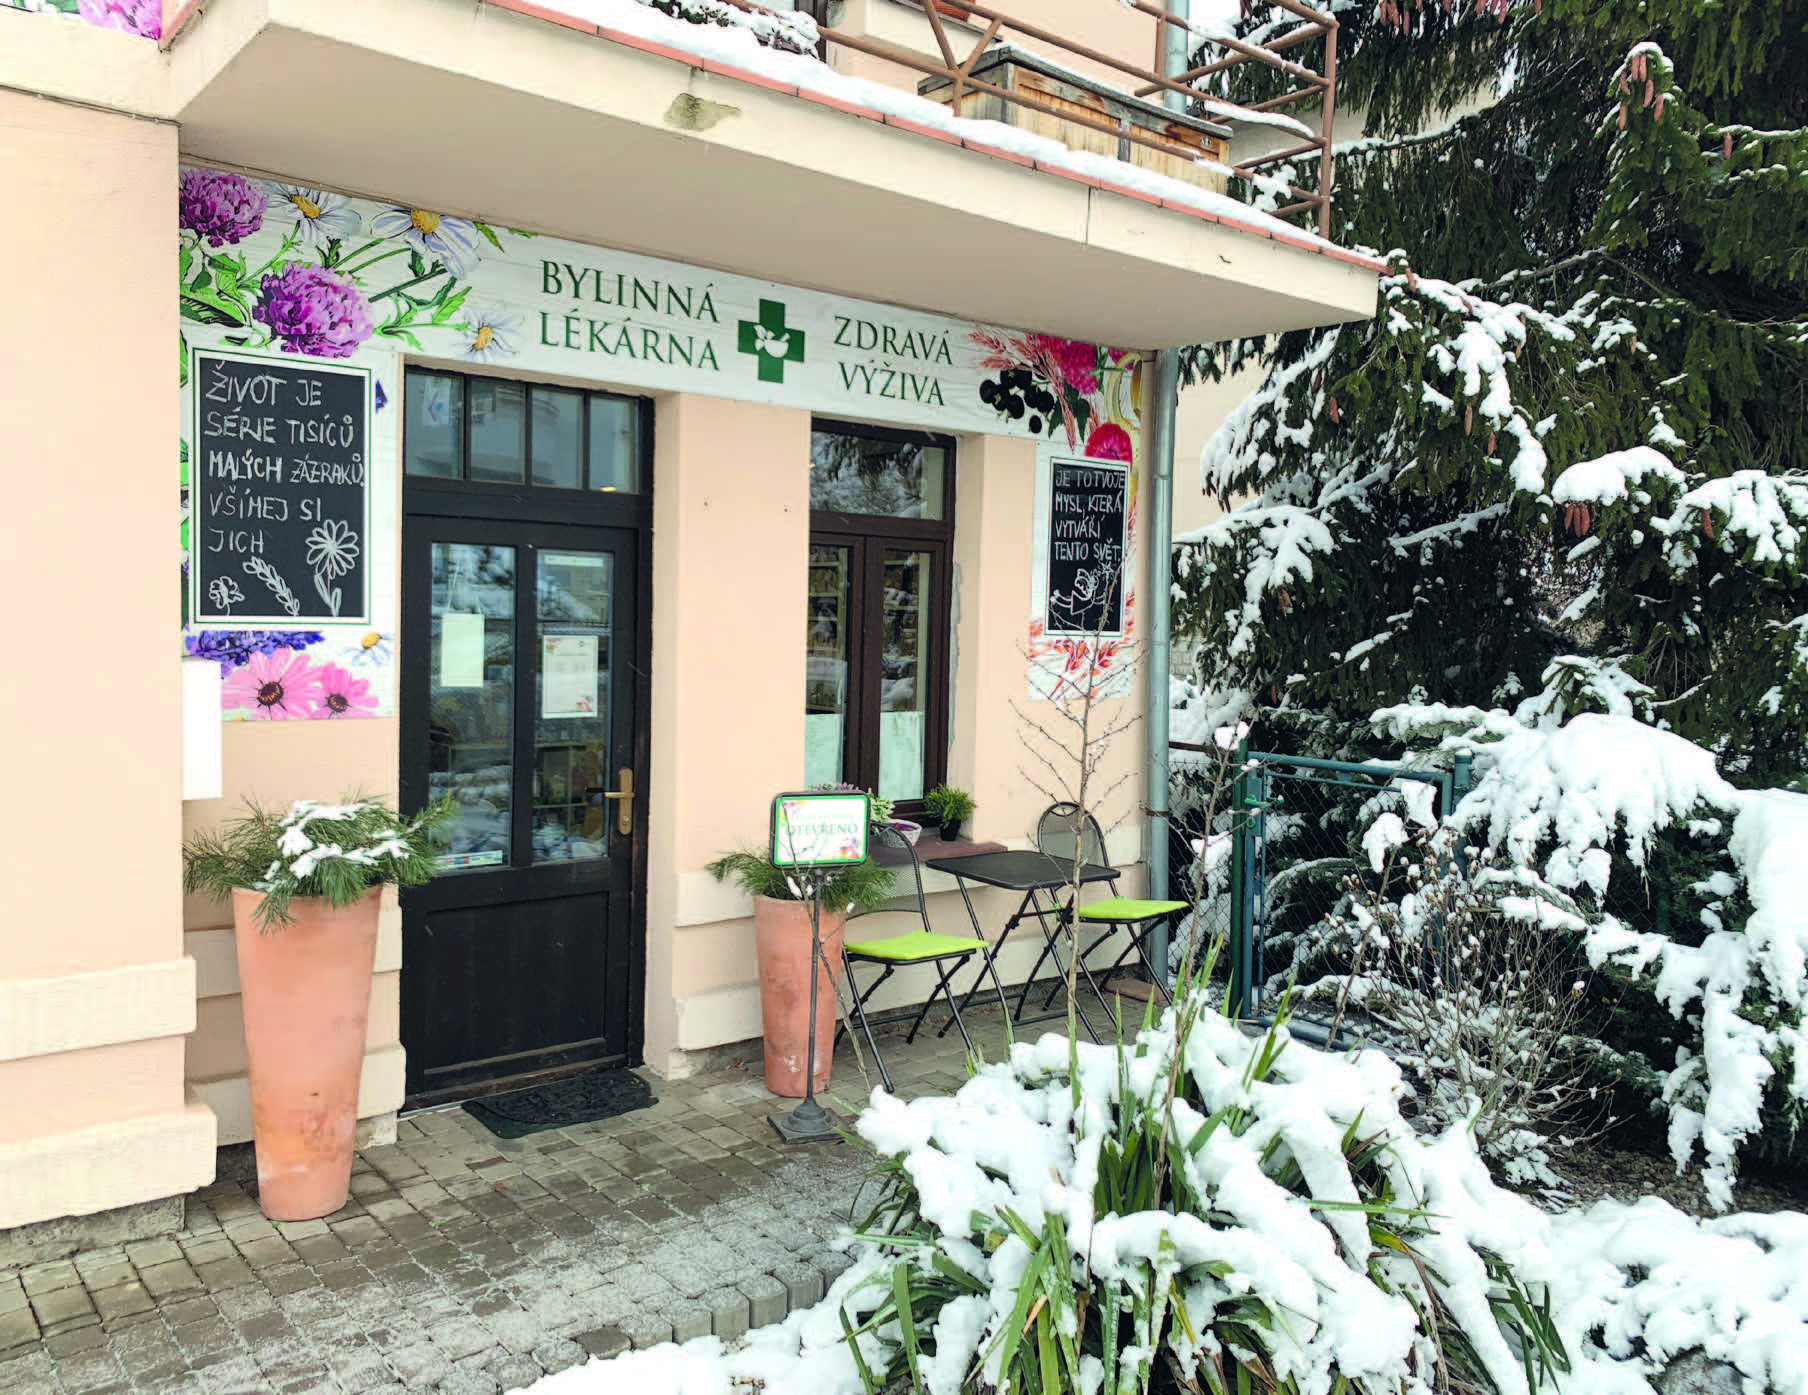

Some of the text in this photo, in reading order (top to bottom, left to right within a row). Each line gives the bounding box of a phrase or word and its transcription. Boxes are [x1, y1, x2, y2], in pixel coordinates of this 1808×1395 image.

[540, 259, 720, 324] BYLINNÁ
[538, 308, 720, 372] LÉKÁRNA
[833, 315, 953, 366] ZDRAVÁ
[205, 359, 322, 406] ŽIVOT JE
[838, 359, 945, 407] VÝŽIVA
[204, 406, 353, 447] SÉRIE TISÍCŮ
[209, 448, 283, 483] MALÝCH
[1055, 470, 1125, 489] JE TO TVOJE
[209, 484, 322, 522] VŠÍMEJ SI
[1088, 491, 1123, 513] KTERÁ
[208, 528, 264, 554] JICH
[1055, 515, 1106, 538] VYTVÁŘÍ
[1054, 538, 1122, 562] TENTO SVĚT.
